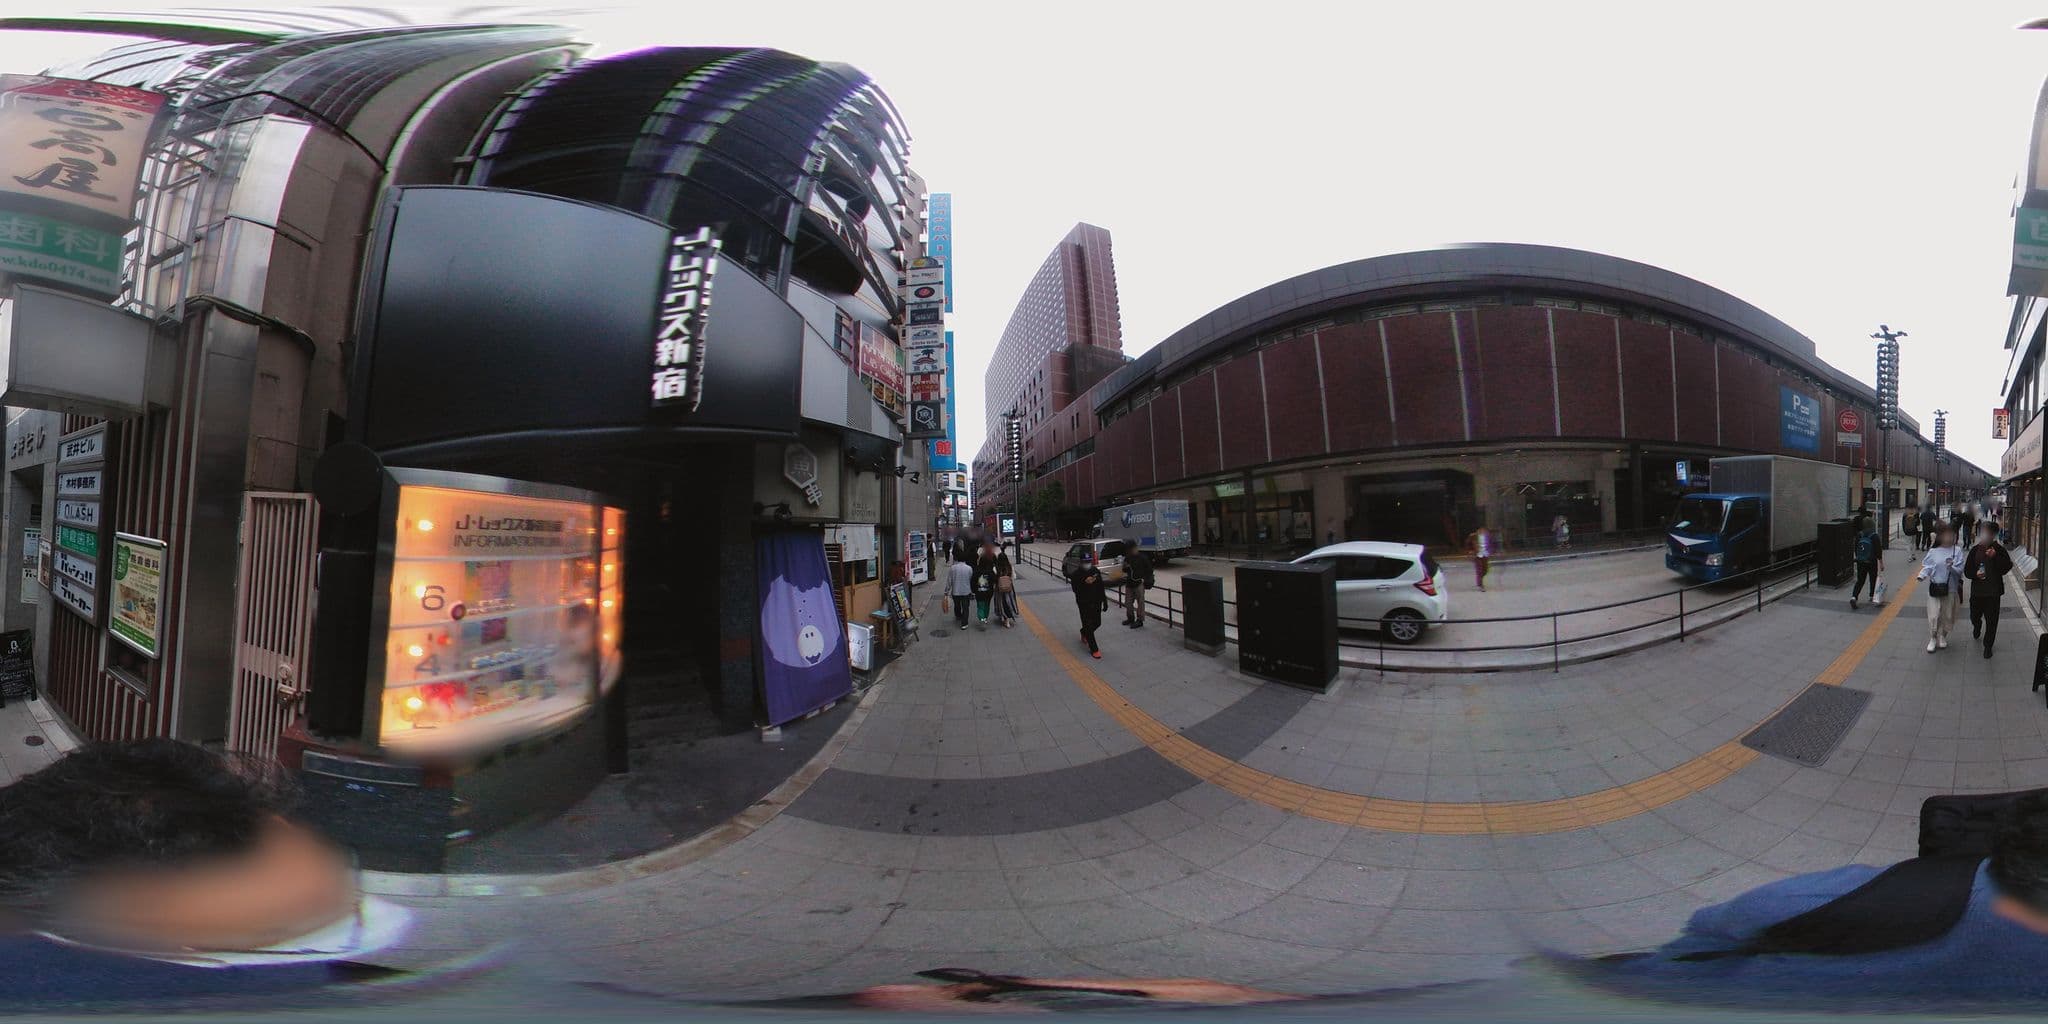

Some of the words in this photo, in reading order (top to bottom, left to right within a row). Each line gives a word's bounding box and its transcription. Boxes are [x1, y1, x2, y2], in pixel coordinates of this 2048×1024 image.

[12, 107, 124, 201] 日高屋
[1128, 512, 1153, 525] HYBRID
[422, 585, 445, 611] 6
